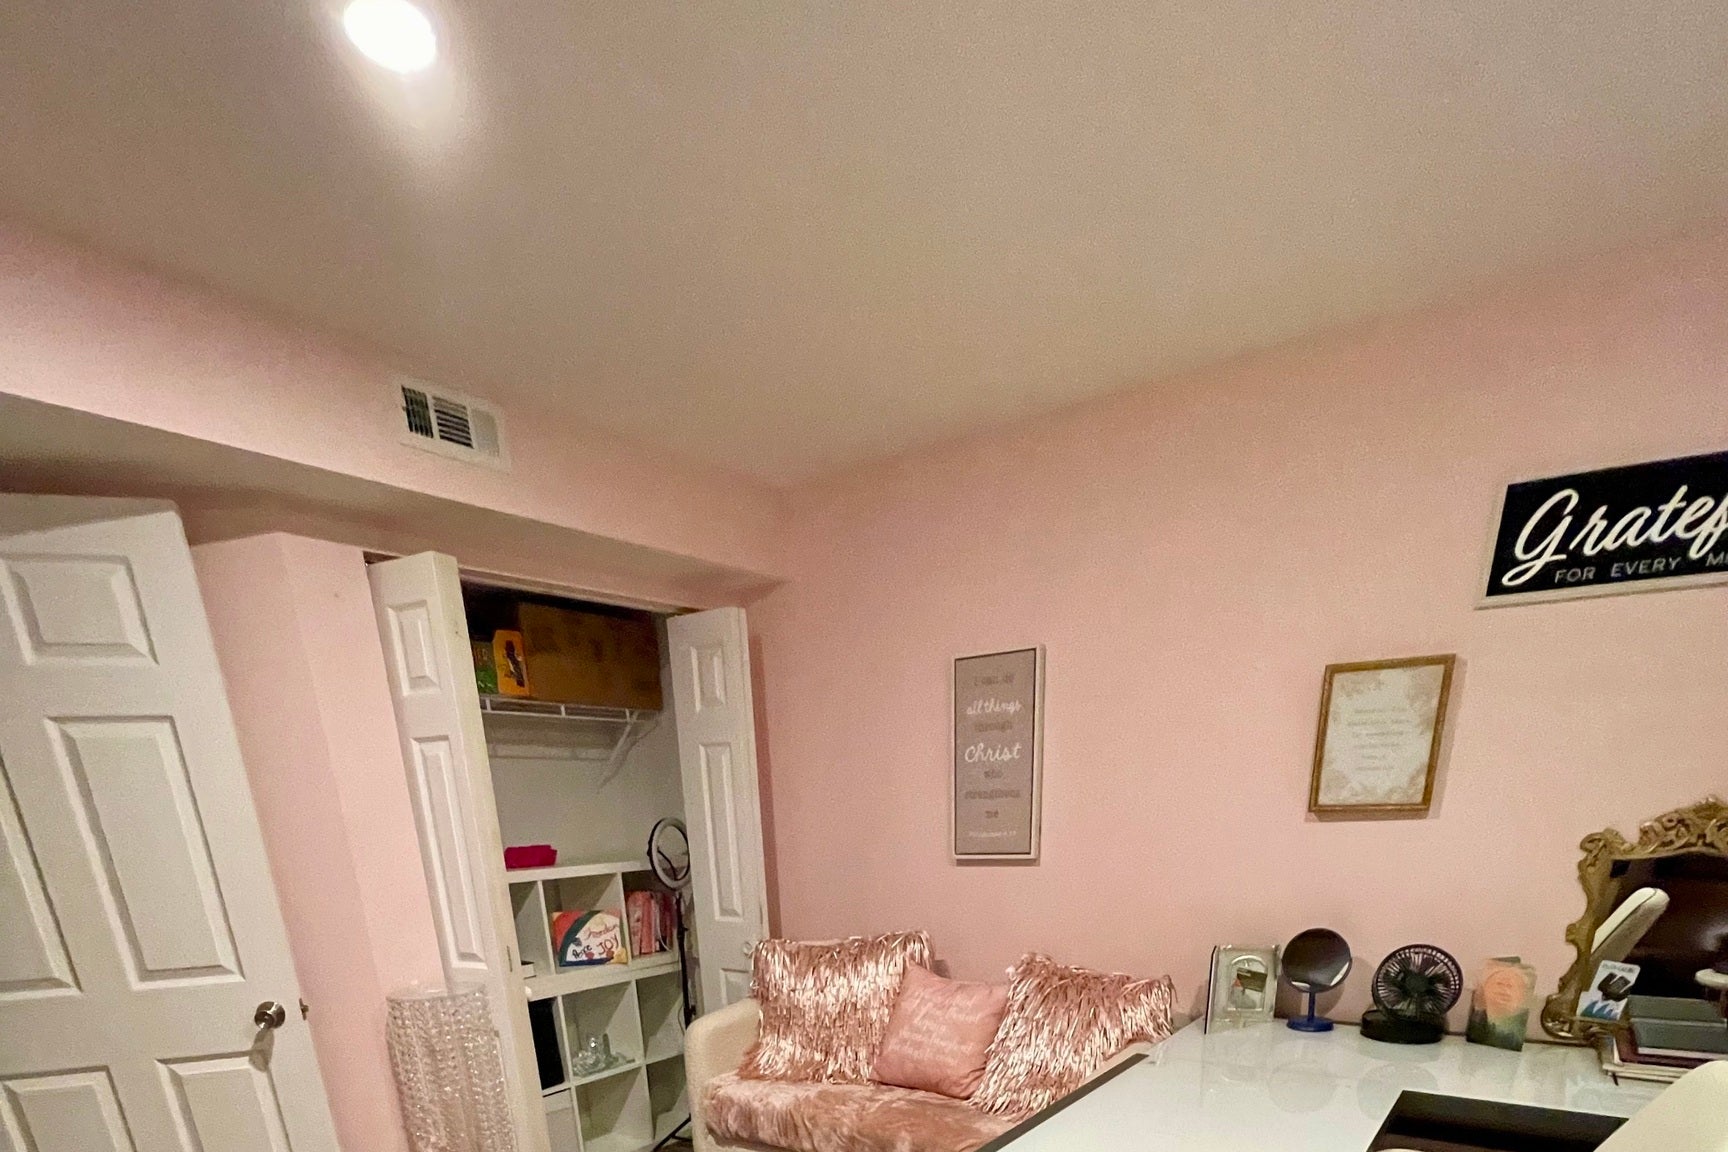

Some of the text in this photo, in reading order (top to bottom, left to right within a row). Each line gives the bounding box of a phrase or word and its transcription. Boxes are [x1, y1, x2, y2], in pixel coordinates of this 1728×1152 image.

[1555, 551, 1728, 583] FOR EVERY M
[964, 742, 1023, 763] Christ
